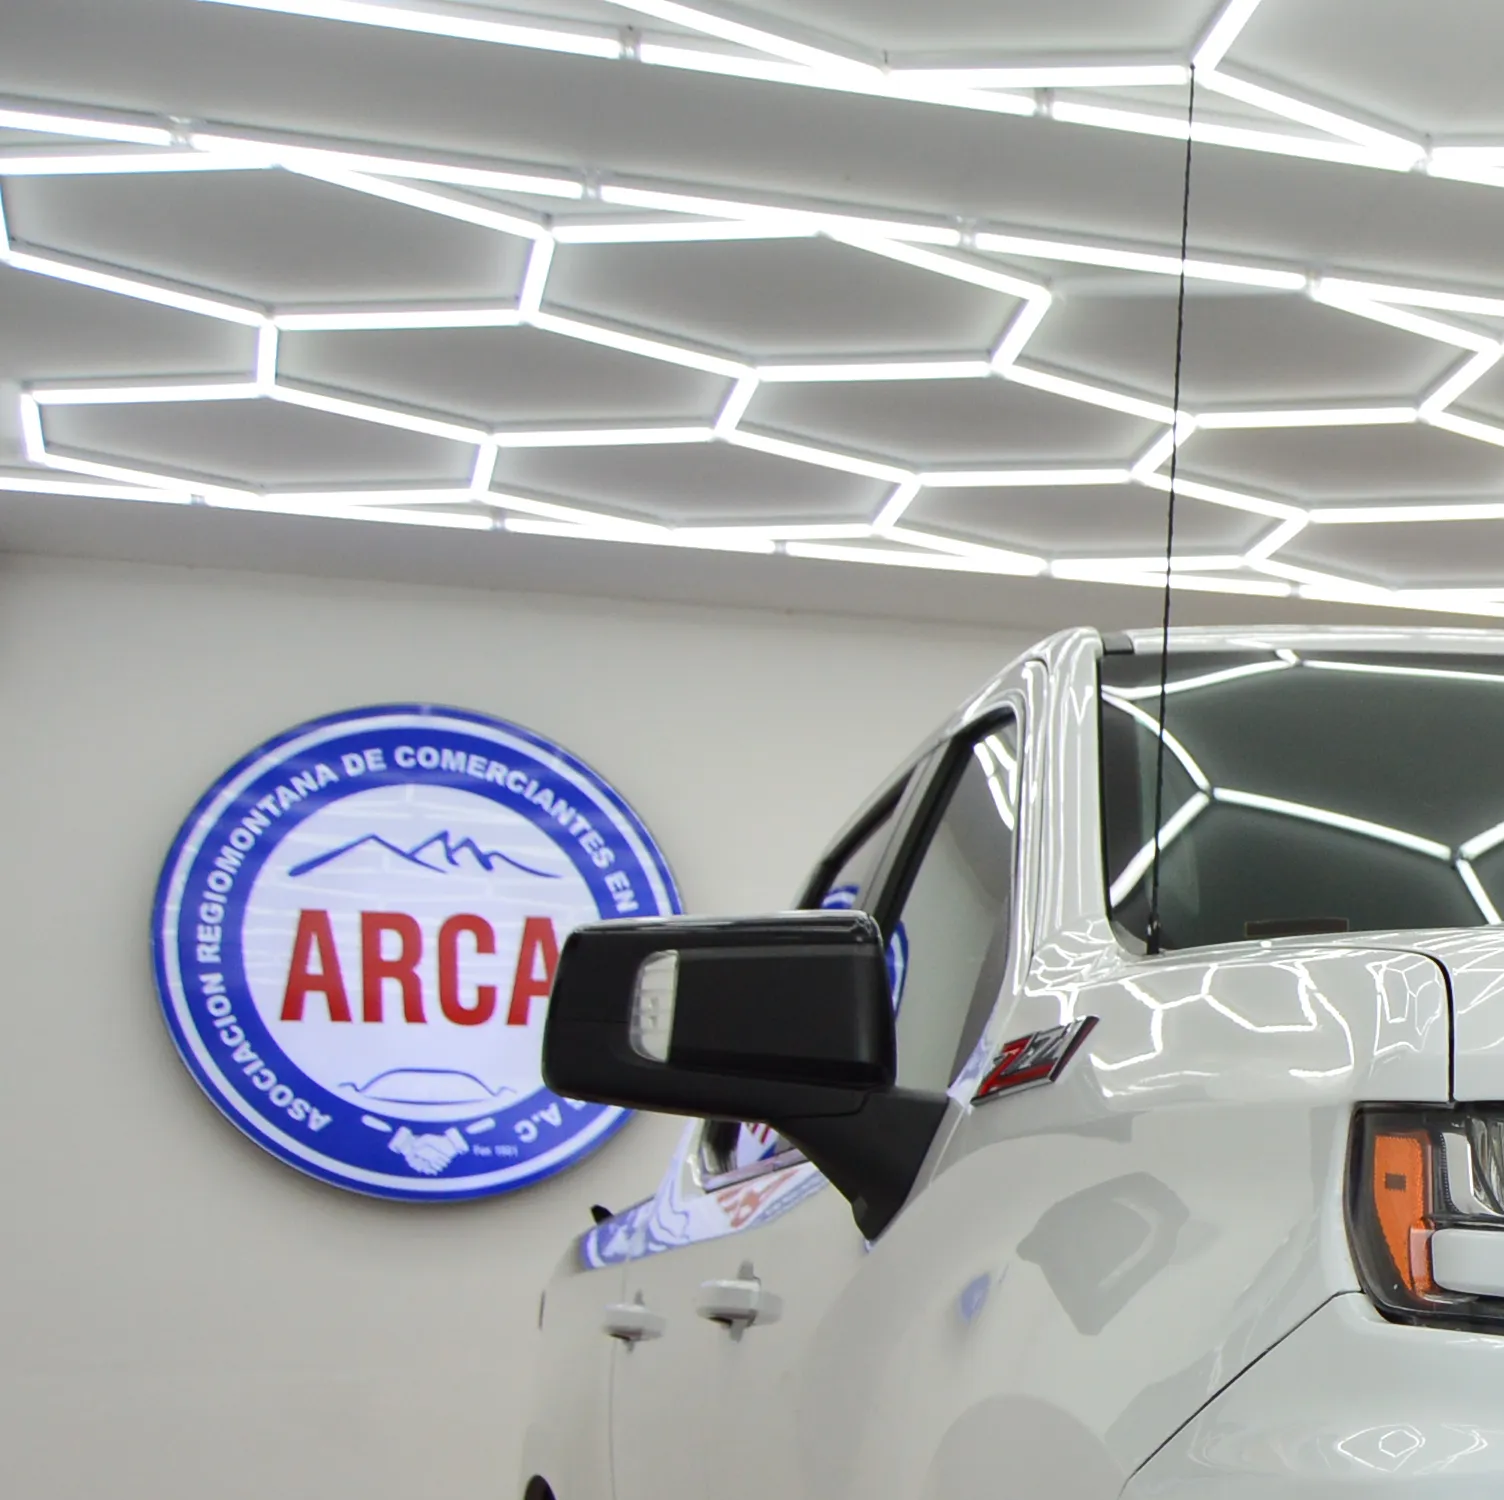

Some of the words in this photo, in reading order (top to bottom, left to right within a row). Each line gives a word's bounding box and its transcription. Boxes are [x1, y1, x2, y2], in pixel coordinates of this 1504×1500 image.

[341, 747, 387, 777] DE
[394, 745, 615, 869] COMERCIANTES
[196, 763, 340, 963] REGIOMONTANA
[604, 870, 640, 914] EN
[279, 908, 560, 1027] ARCA
[200, 972, 334, 1131] ASOCIACION
